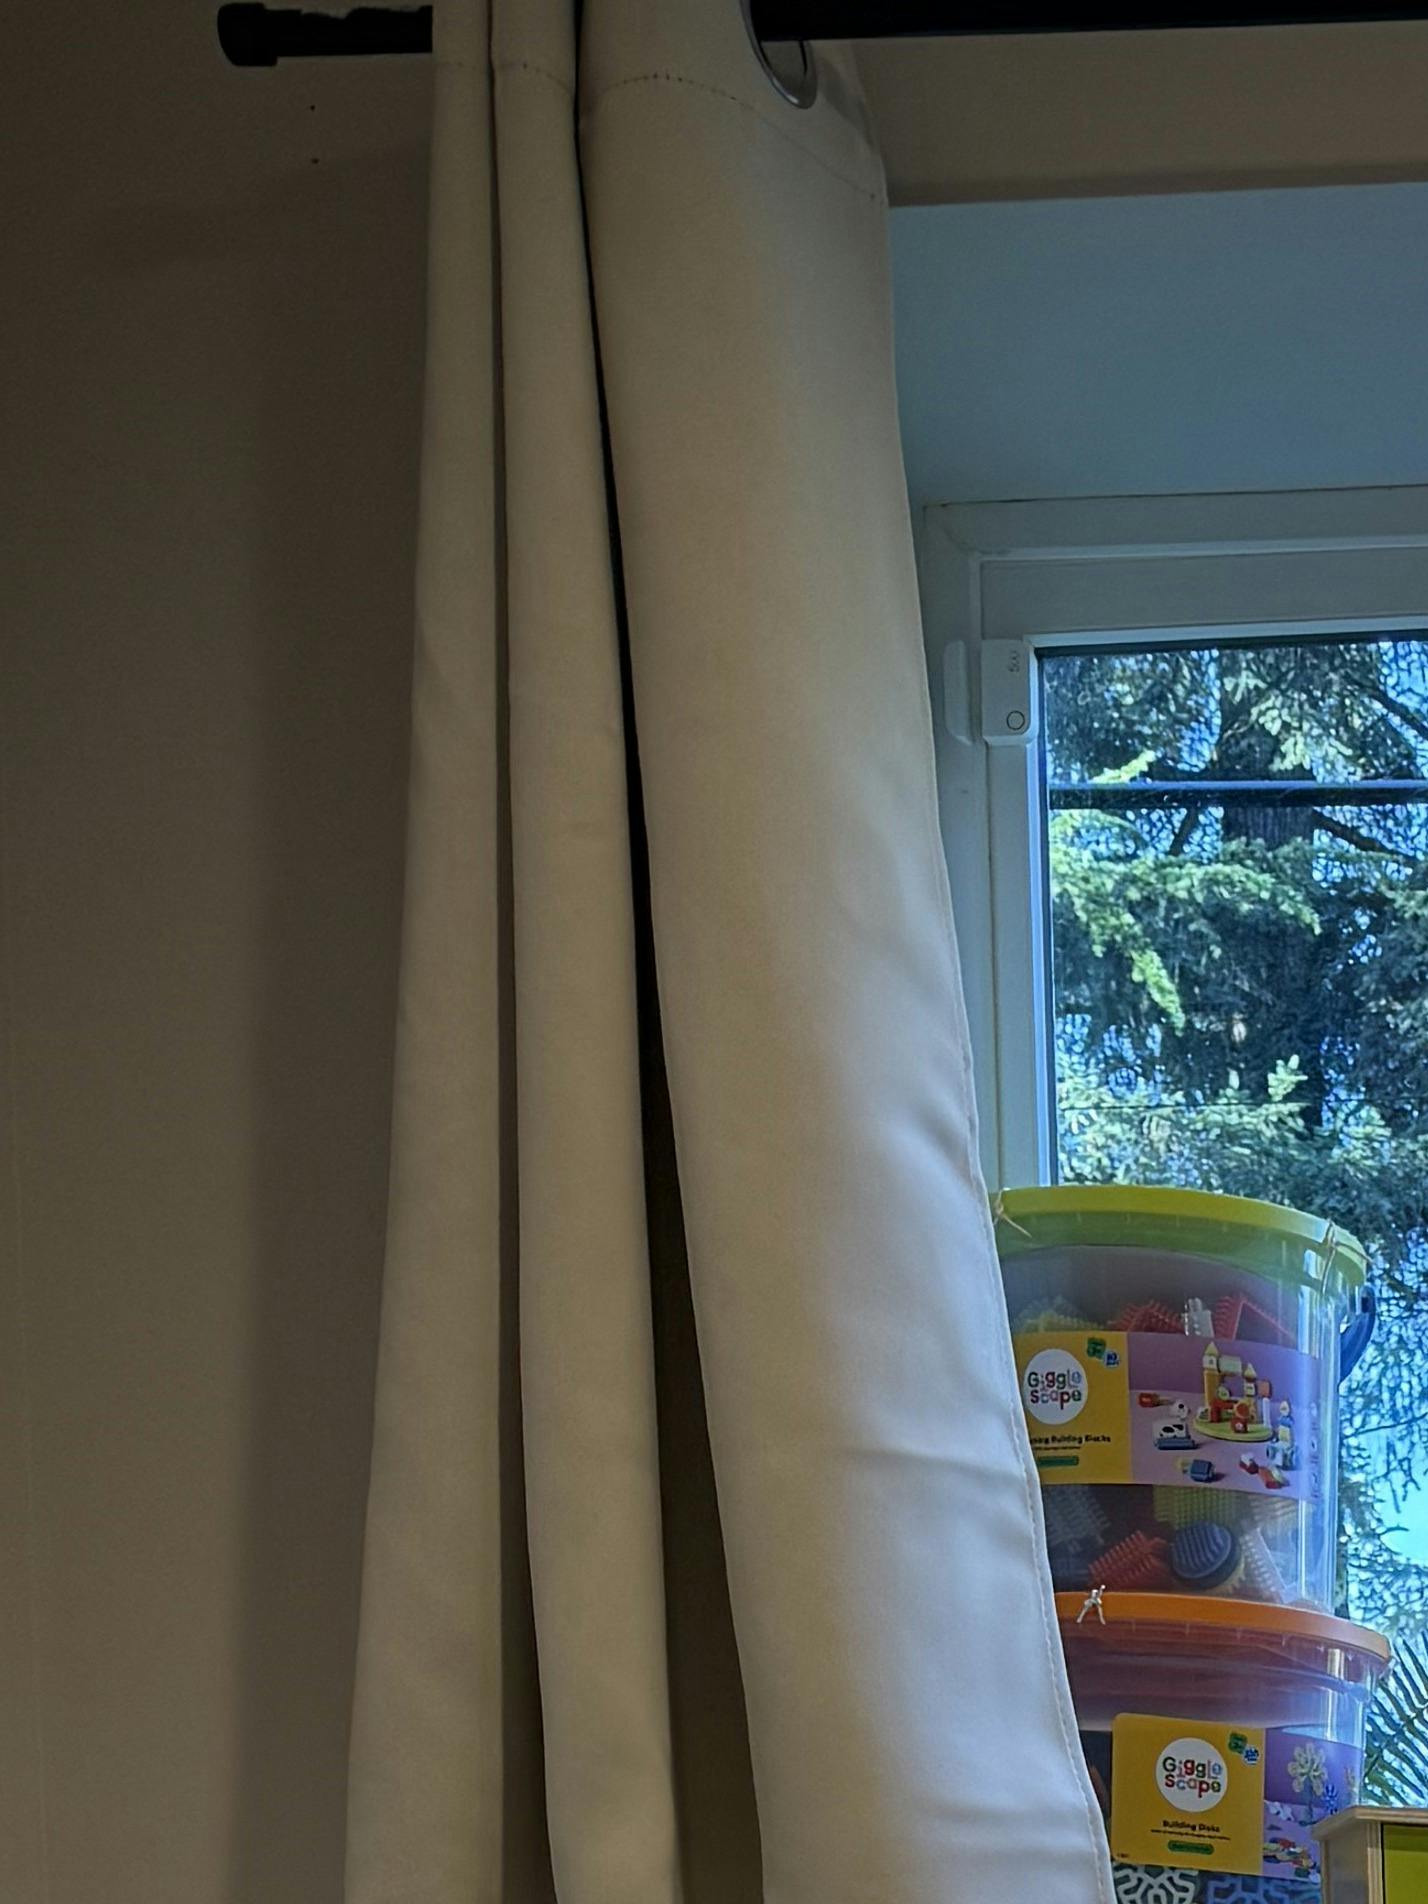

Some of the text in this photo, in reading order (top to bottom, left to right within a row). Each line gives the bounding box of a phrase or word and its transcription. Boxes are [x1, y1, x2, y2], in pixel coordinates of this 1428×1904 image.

[1027, 1368, 1082, 1391] Giggle
[1030, 1389, 1082, 1410] Scape
[1162, 1756, 1222, 1779] Giggle
[1164, 1774, 1222, 1799] Scape
